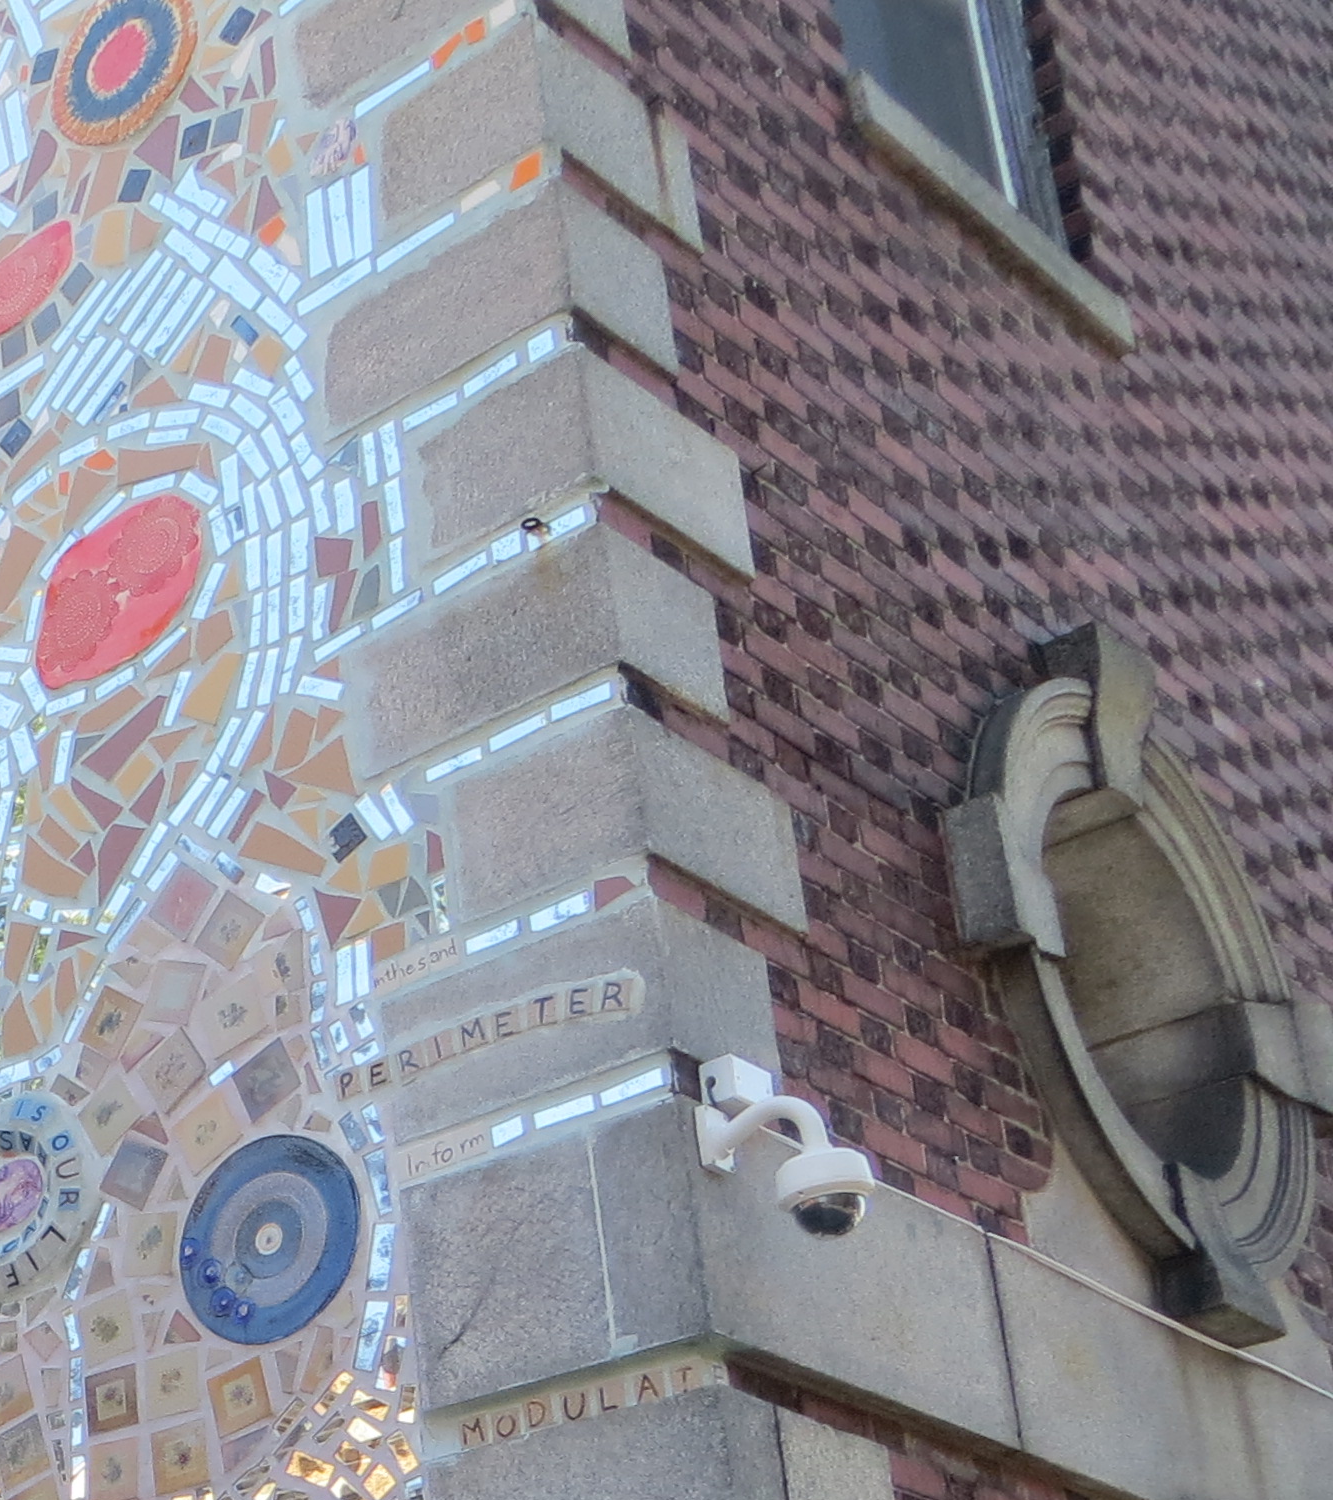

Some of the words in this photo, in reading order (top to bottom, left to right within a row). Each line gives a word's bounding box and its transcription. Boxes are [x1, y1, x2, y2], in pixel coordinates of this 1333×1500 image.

[337, 979, 626, 1100] PERIMETER
[16, 1099, 48, 1123] IS
[51, 1133, 82, 1207] OUR
